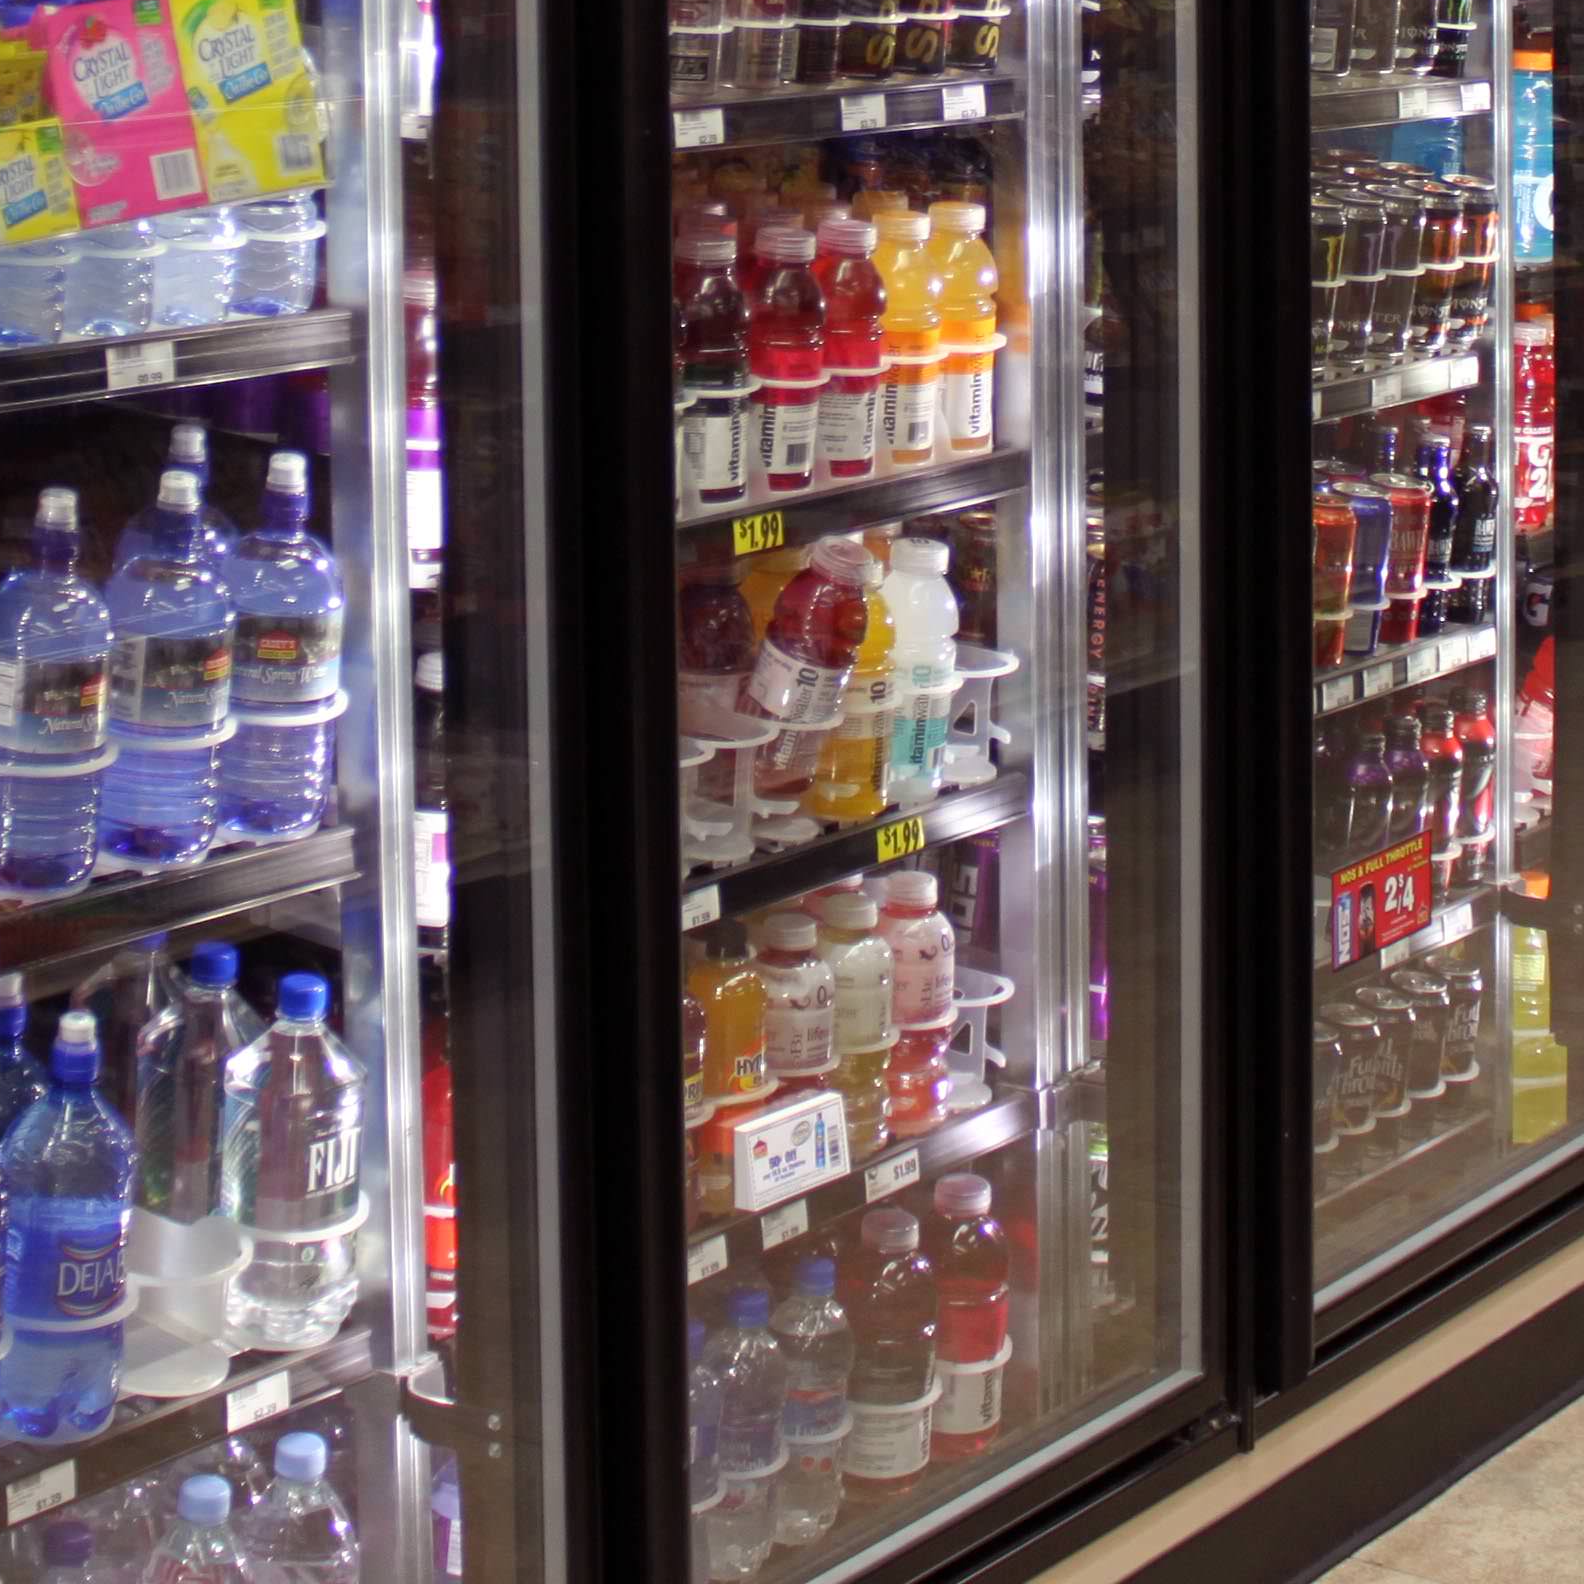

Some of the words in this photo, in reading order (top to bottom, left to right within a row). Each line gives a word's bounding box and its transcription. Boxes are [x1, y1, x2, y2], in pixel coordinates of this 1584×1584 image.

[72, 42, 130, 82] CRYSTAL
[198, 24, 255, 62] CRYSTAL
[93, 64, 131, 98] LIGHT
[218, 45, 257, 80] LIGHT
[738, 513, 780, 550] $1.99
[883, 818, 919, 856] $1.99
[1340, 868, 1357, 885] NOS
[1365, 855, 1384, 875] FULL
[1384, 837, 1424, 866] THROTTLE
[307, 1125, 362, 1193] FIJI
[892, 1152, 917, 1181] $1.99
